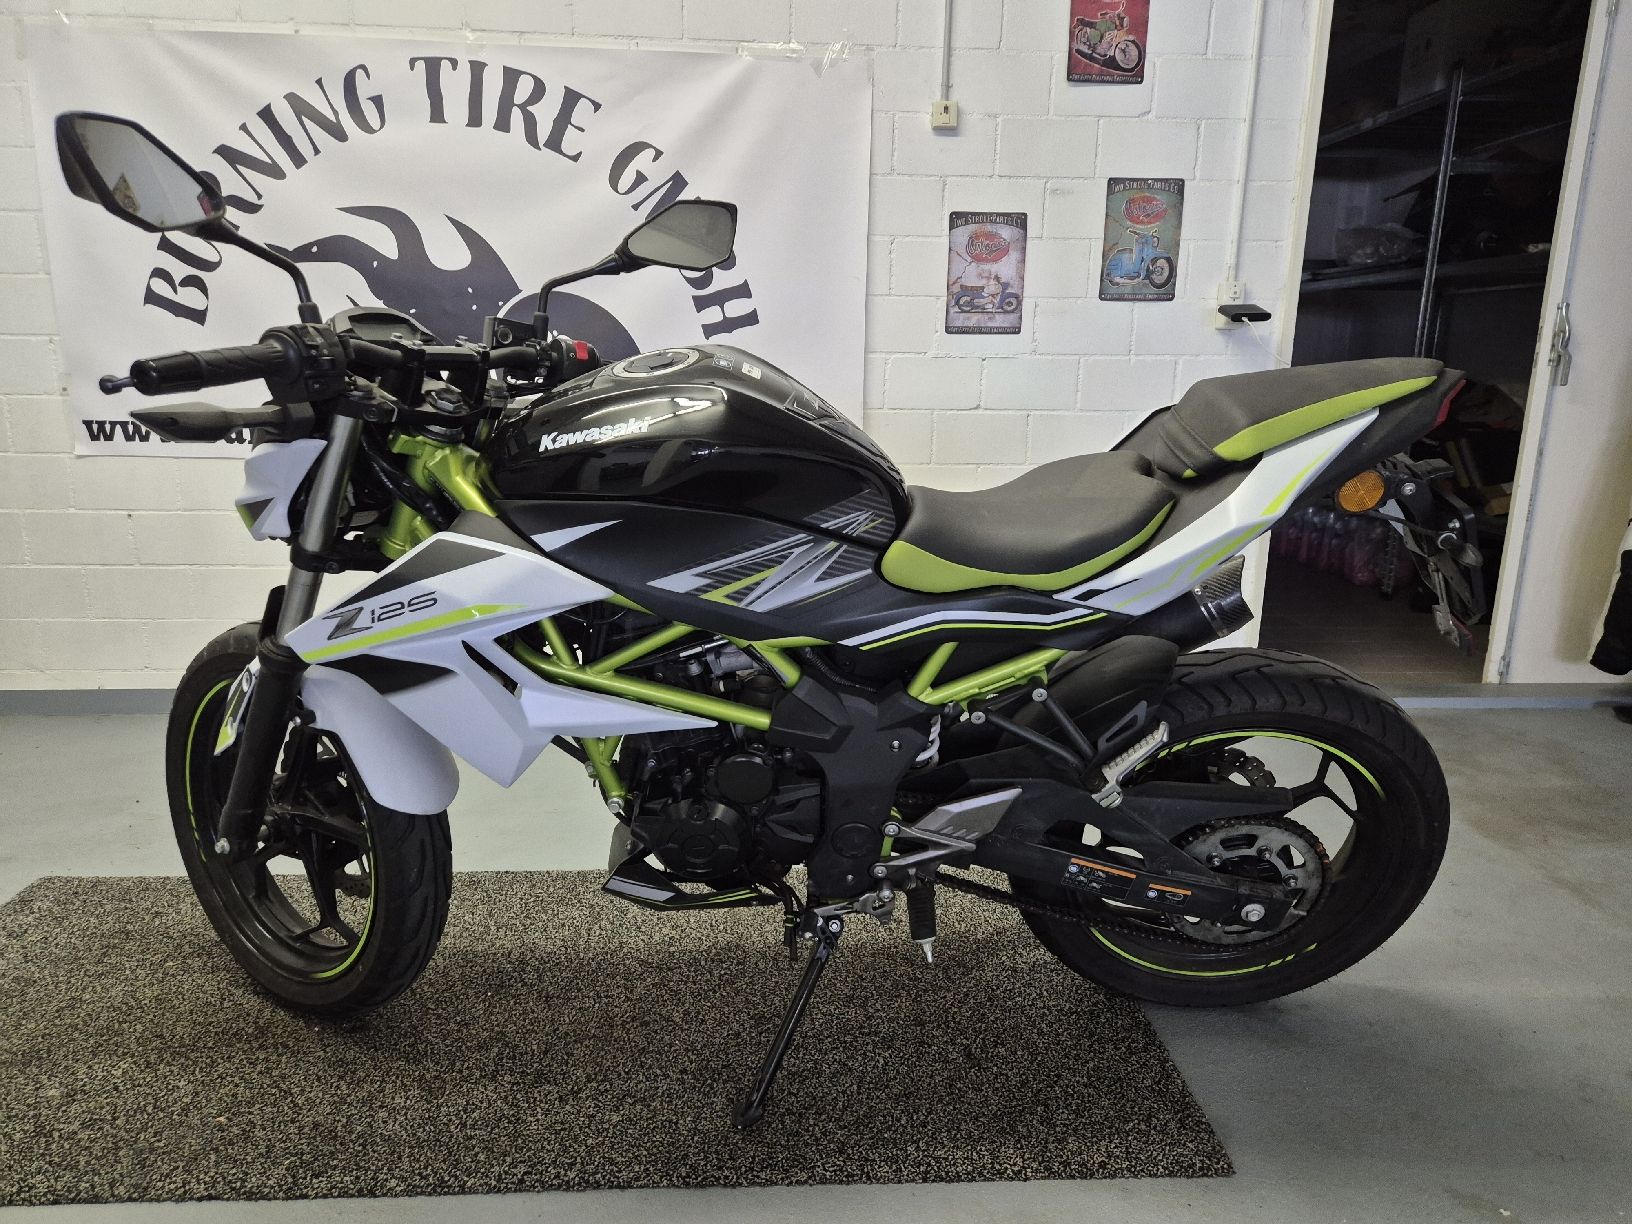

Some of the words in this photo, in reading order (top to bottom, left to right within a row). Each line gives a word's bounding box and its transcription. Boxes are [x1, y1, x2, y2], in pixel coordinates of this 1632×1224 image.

[408, 56, 603, 164] TIRE
[538, 416, 651, 453] Kawasaki
[321, 590, 438, 641] Z125
